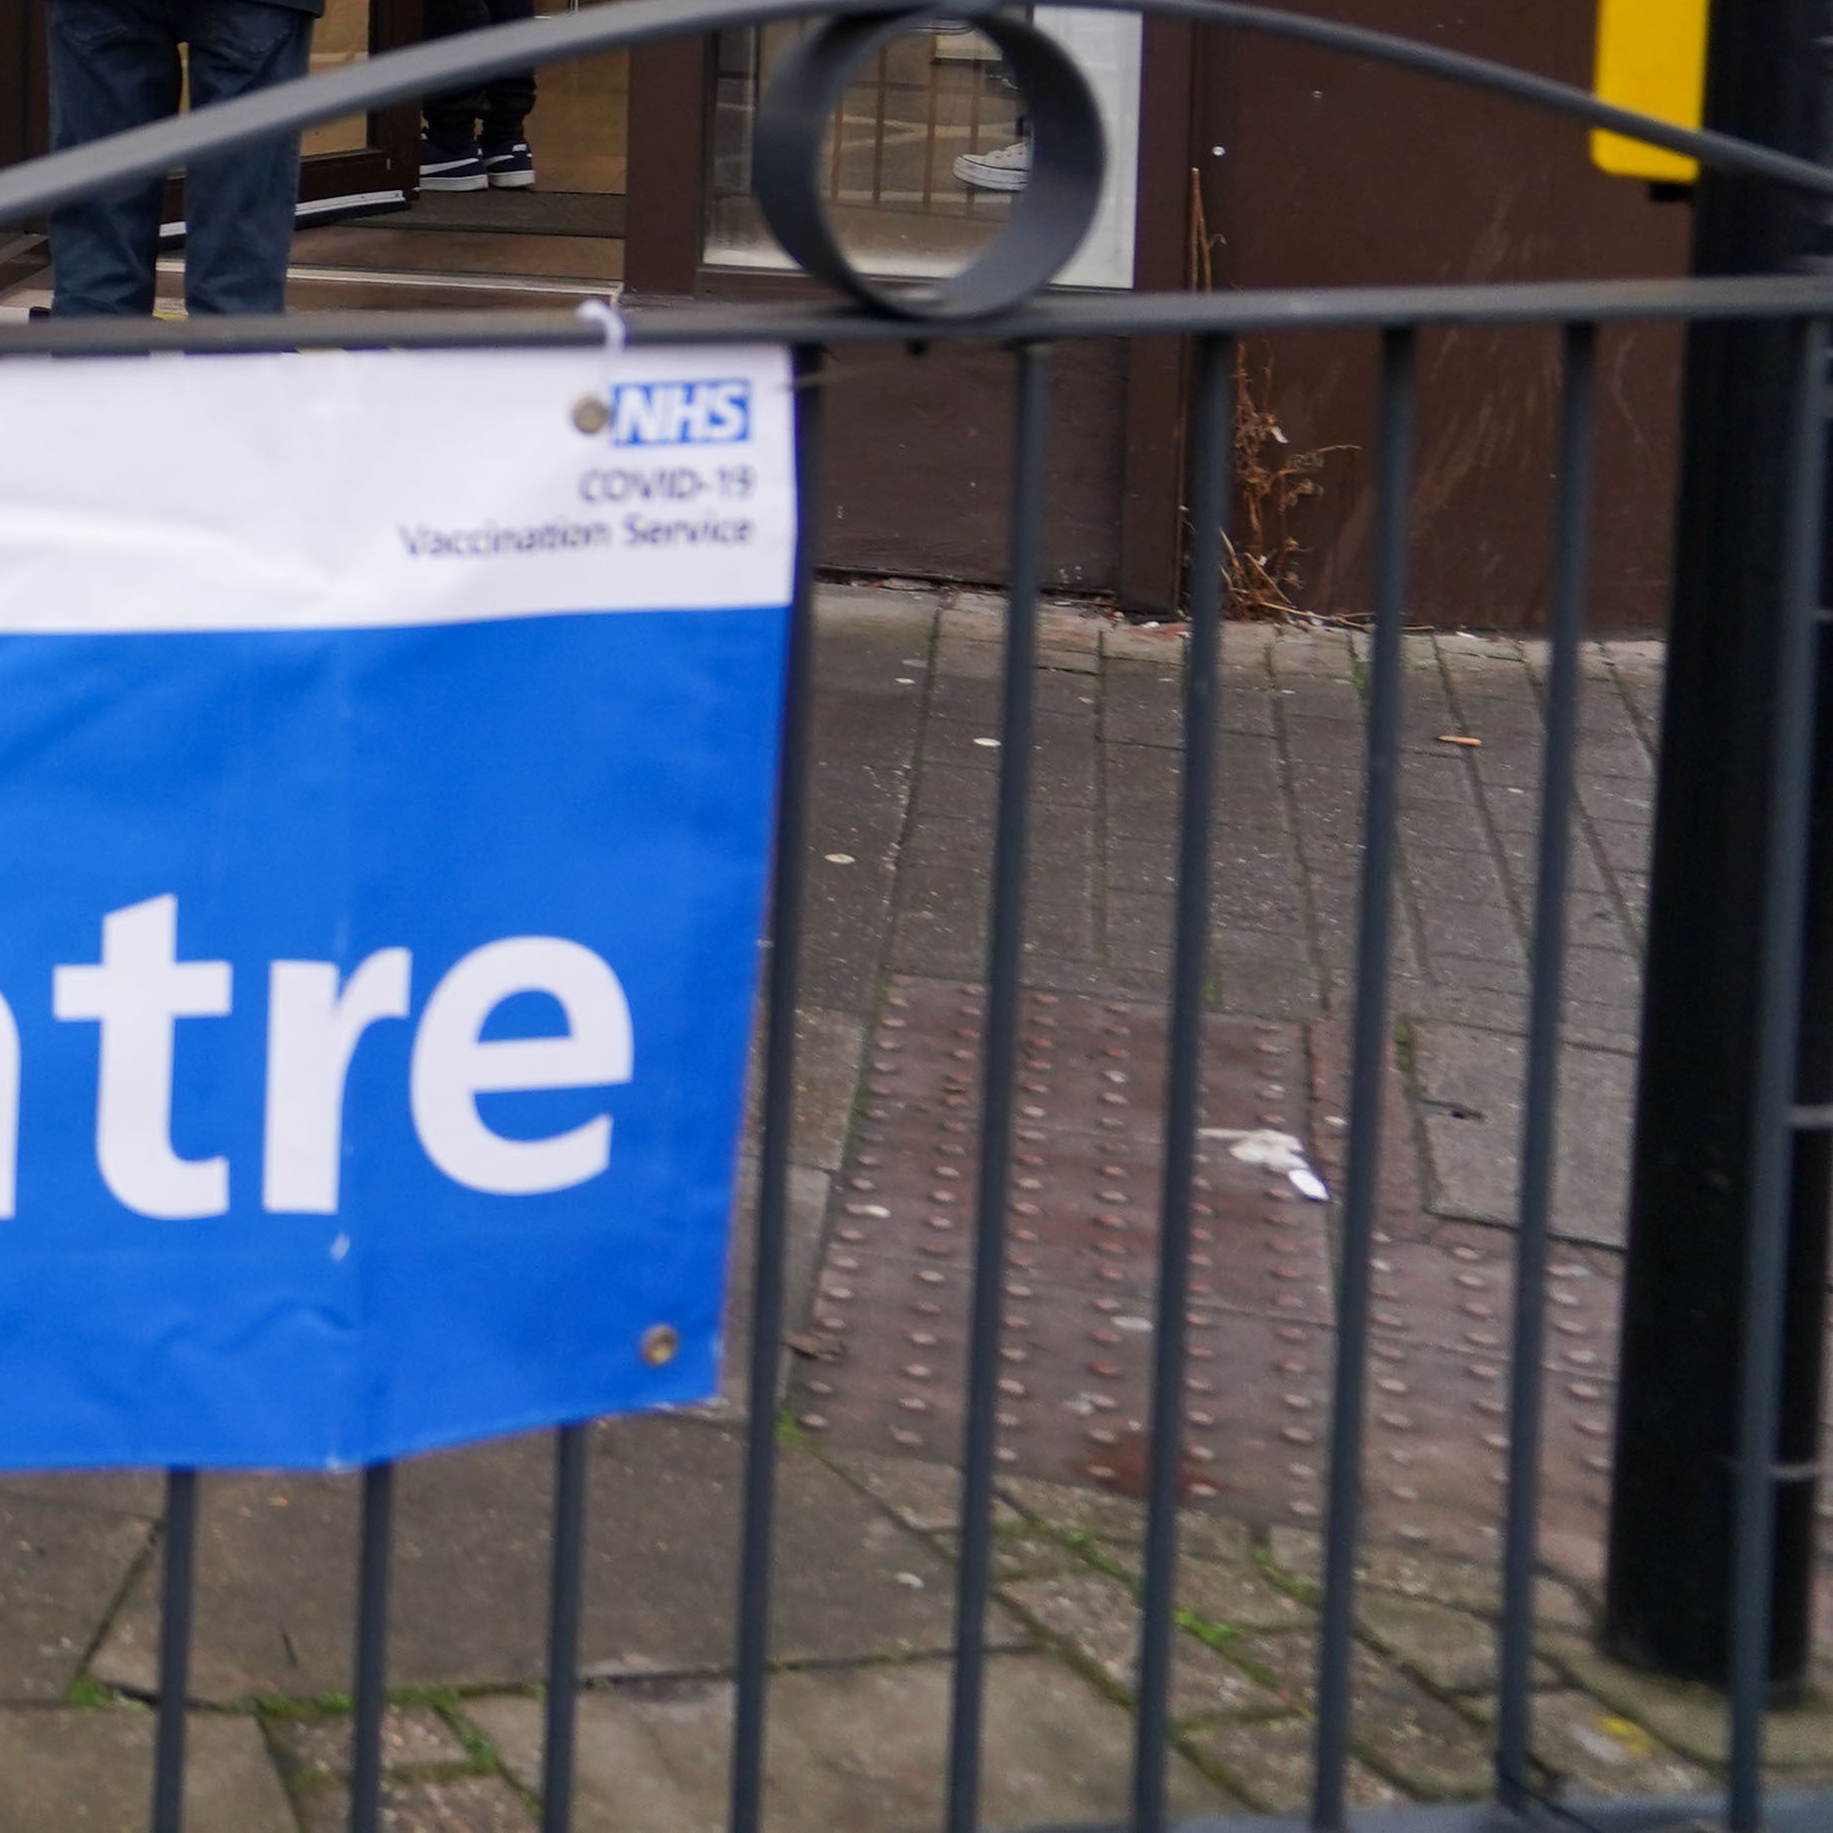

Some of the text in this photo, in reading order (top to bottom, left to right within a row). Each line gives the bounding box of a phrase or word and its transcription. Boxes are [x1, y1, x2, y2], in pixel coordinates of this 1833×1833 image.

[612, 384, 748, 443] NHS
[579, 466, 754, 502] COVID-19
[398, 513, 754, 556] Vaccination Service
